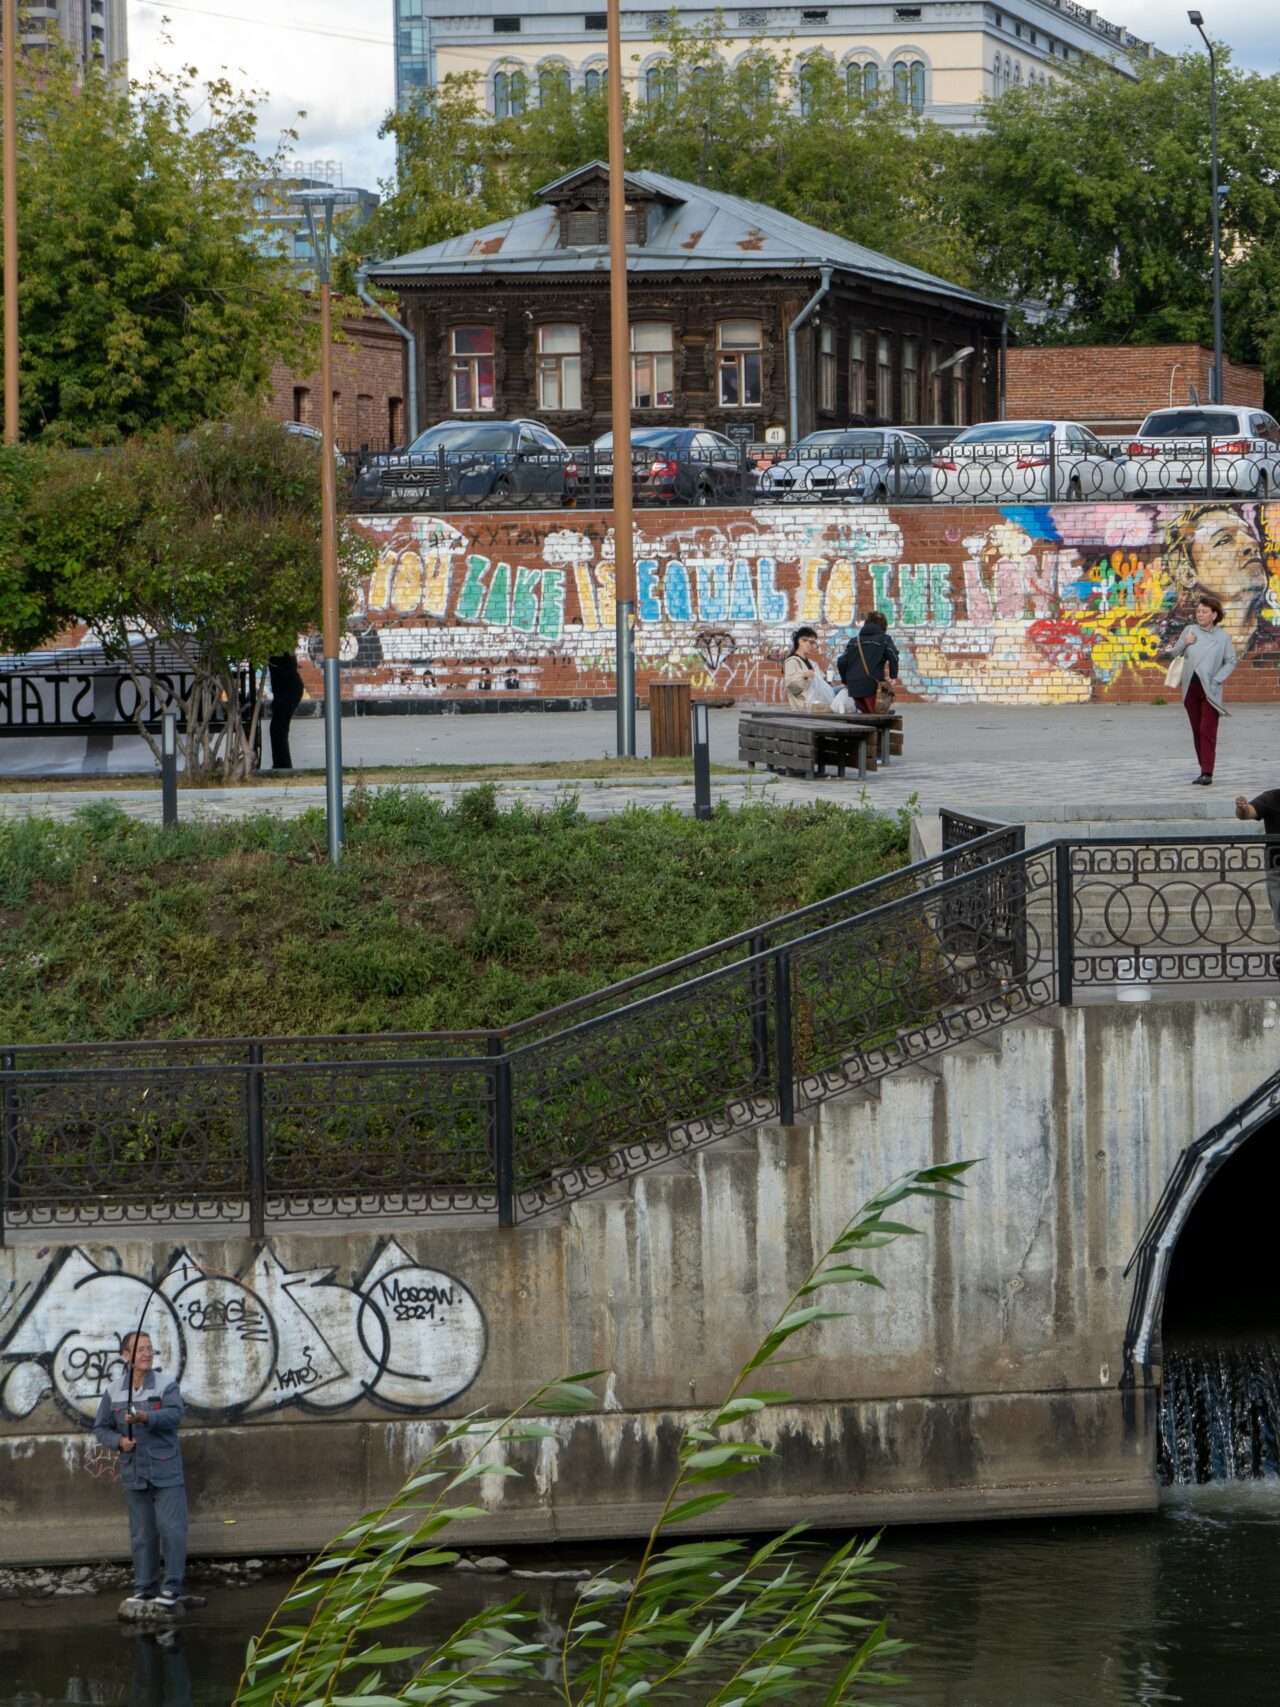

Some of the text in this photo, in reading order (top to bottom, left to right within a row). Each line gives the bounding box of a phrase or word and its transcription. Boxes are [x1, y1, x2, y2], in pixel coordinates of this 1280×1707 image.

[770, 430, 780, 441] 41
[368, 550, 452, 618] YOU
[635, 557, 789, 623] EQUAL
